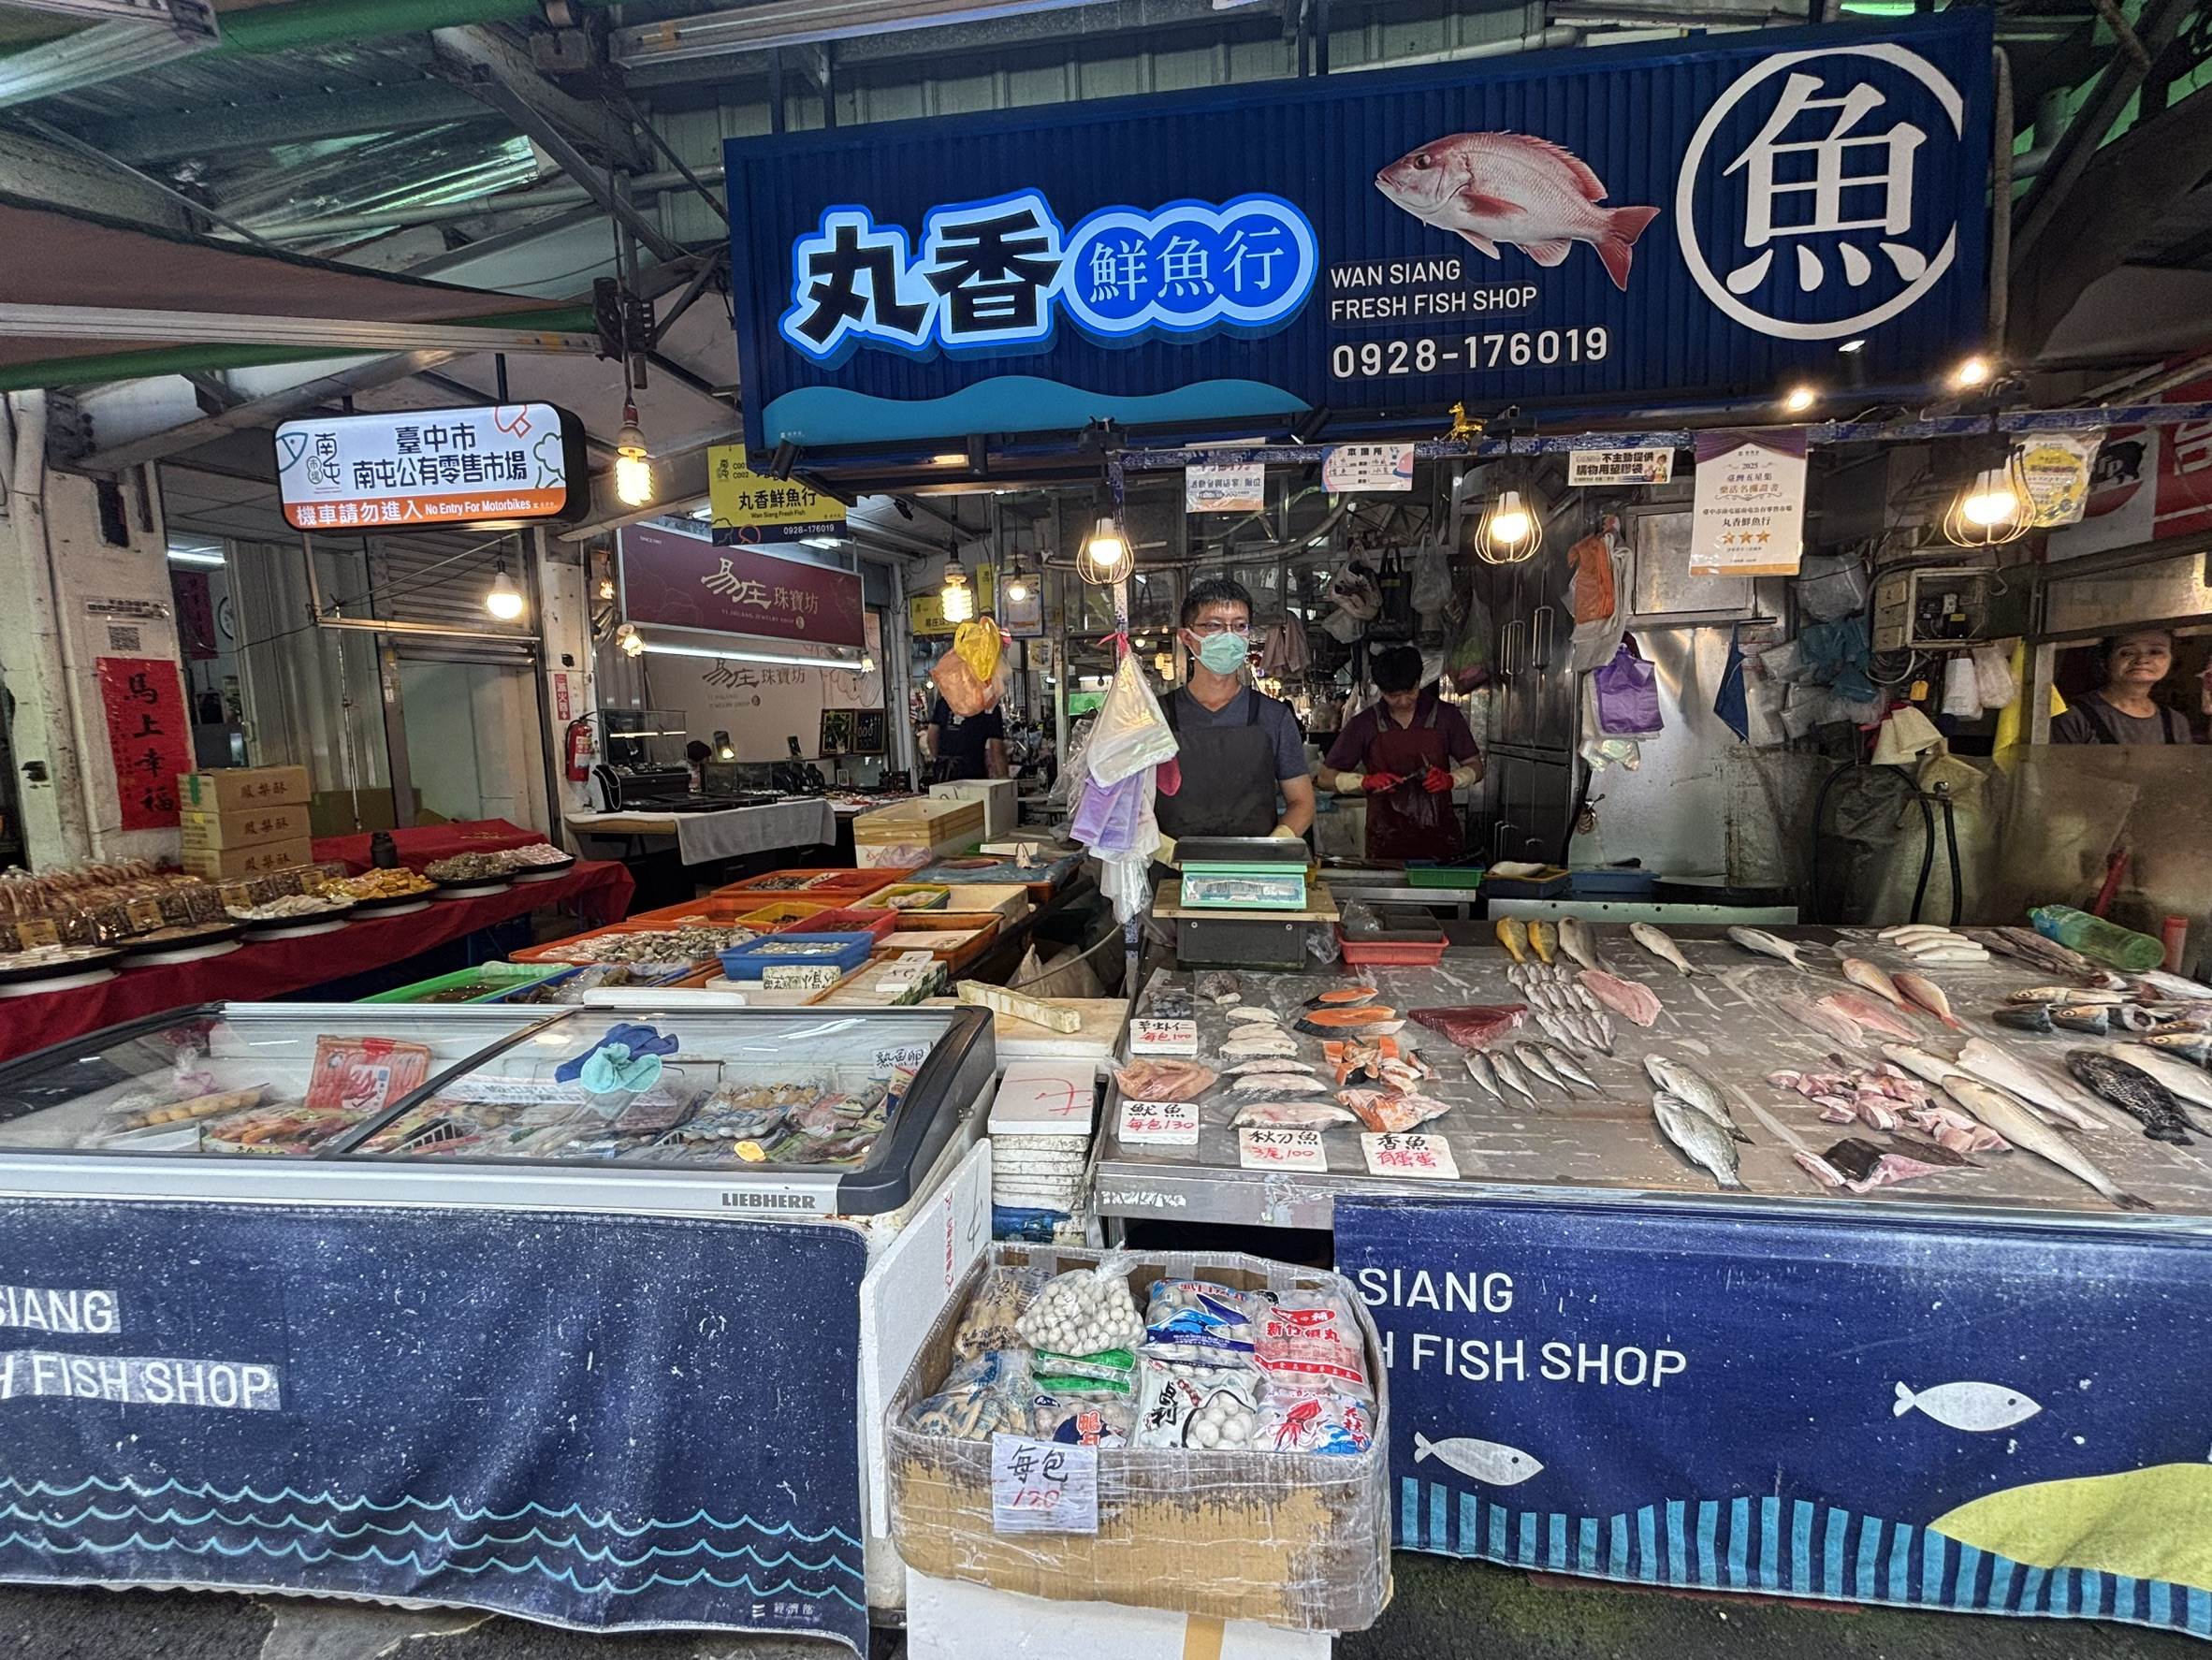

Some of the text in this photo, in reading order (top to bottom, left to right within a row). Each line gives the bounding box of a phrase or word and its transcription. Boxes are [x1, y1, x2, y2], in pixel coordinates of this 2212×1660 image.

[1724, 73, 1928, 294] 魚
[796, 209, 1286, 342] 丸香 鮮魚行
[1331, 259, 1461, 288] WAN SIANG
[1332, 286, 1537, 320] FRESH FISH SHOP
[1332, 328, 1608, 378] 0928-176019
[395, 423, 476, 454] 臺中市
[354, 450, 527, 489] 南屯公有零售市場
[297, 502, 423, 526] 機車請勿進入
[425, 504, 438, 516] No
[440, 502, 463, 515] Entry
[465, 502, 480, 512] For
[482, 499, 531, 511] Motorbikes
[738, 488, 817, 511] 丸香鮮魚行
[783, 524, 835, 535] 0928-176019
[1723, 517, 1771, 527] 丸香鮮魚行
[773, 587, 819, 615] 珠寶坊
[123, 673, 175, 812] 馬上幸福
[1248, 1129, 1318, 1145] 秋刀魚
[1377, 1132, 1430, 1151] 香魚
[721, 1193, 816, 1209] LIEBHERR
[1359, 1267, 1514, 1313] SIANG
[0, 1287, 113, 1332] IANG
[1413, 1333, 1524, 1382] FISH
[1540, 1342, 1686, 1388] SHOP
[33, 1356, 129, 1402] FISH
[144, 1361, 270, 1408] SHOP
[1007, 1444, 1068, 1484] 每包
